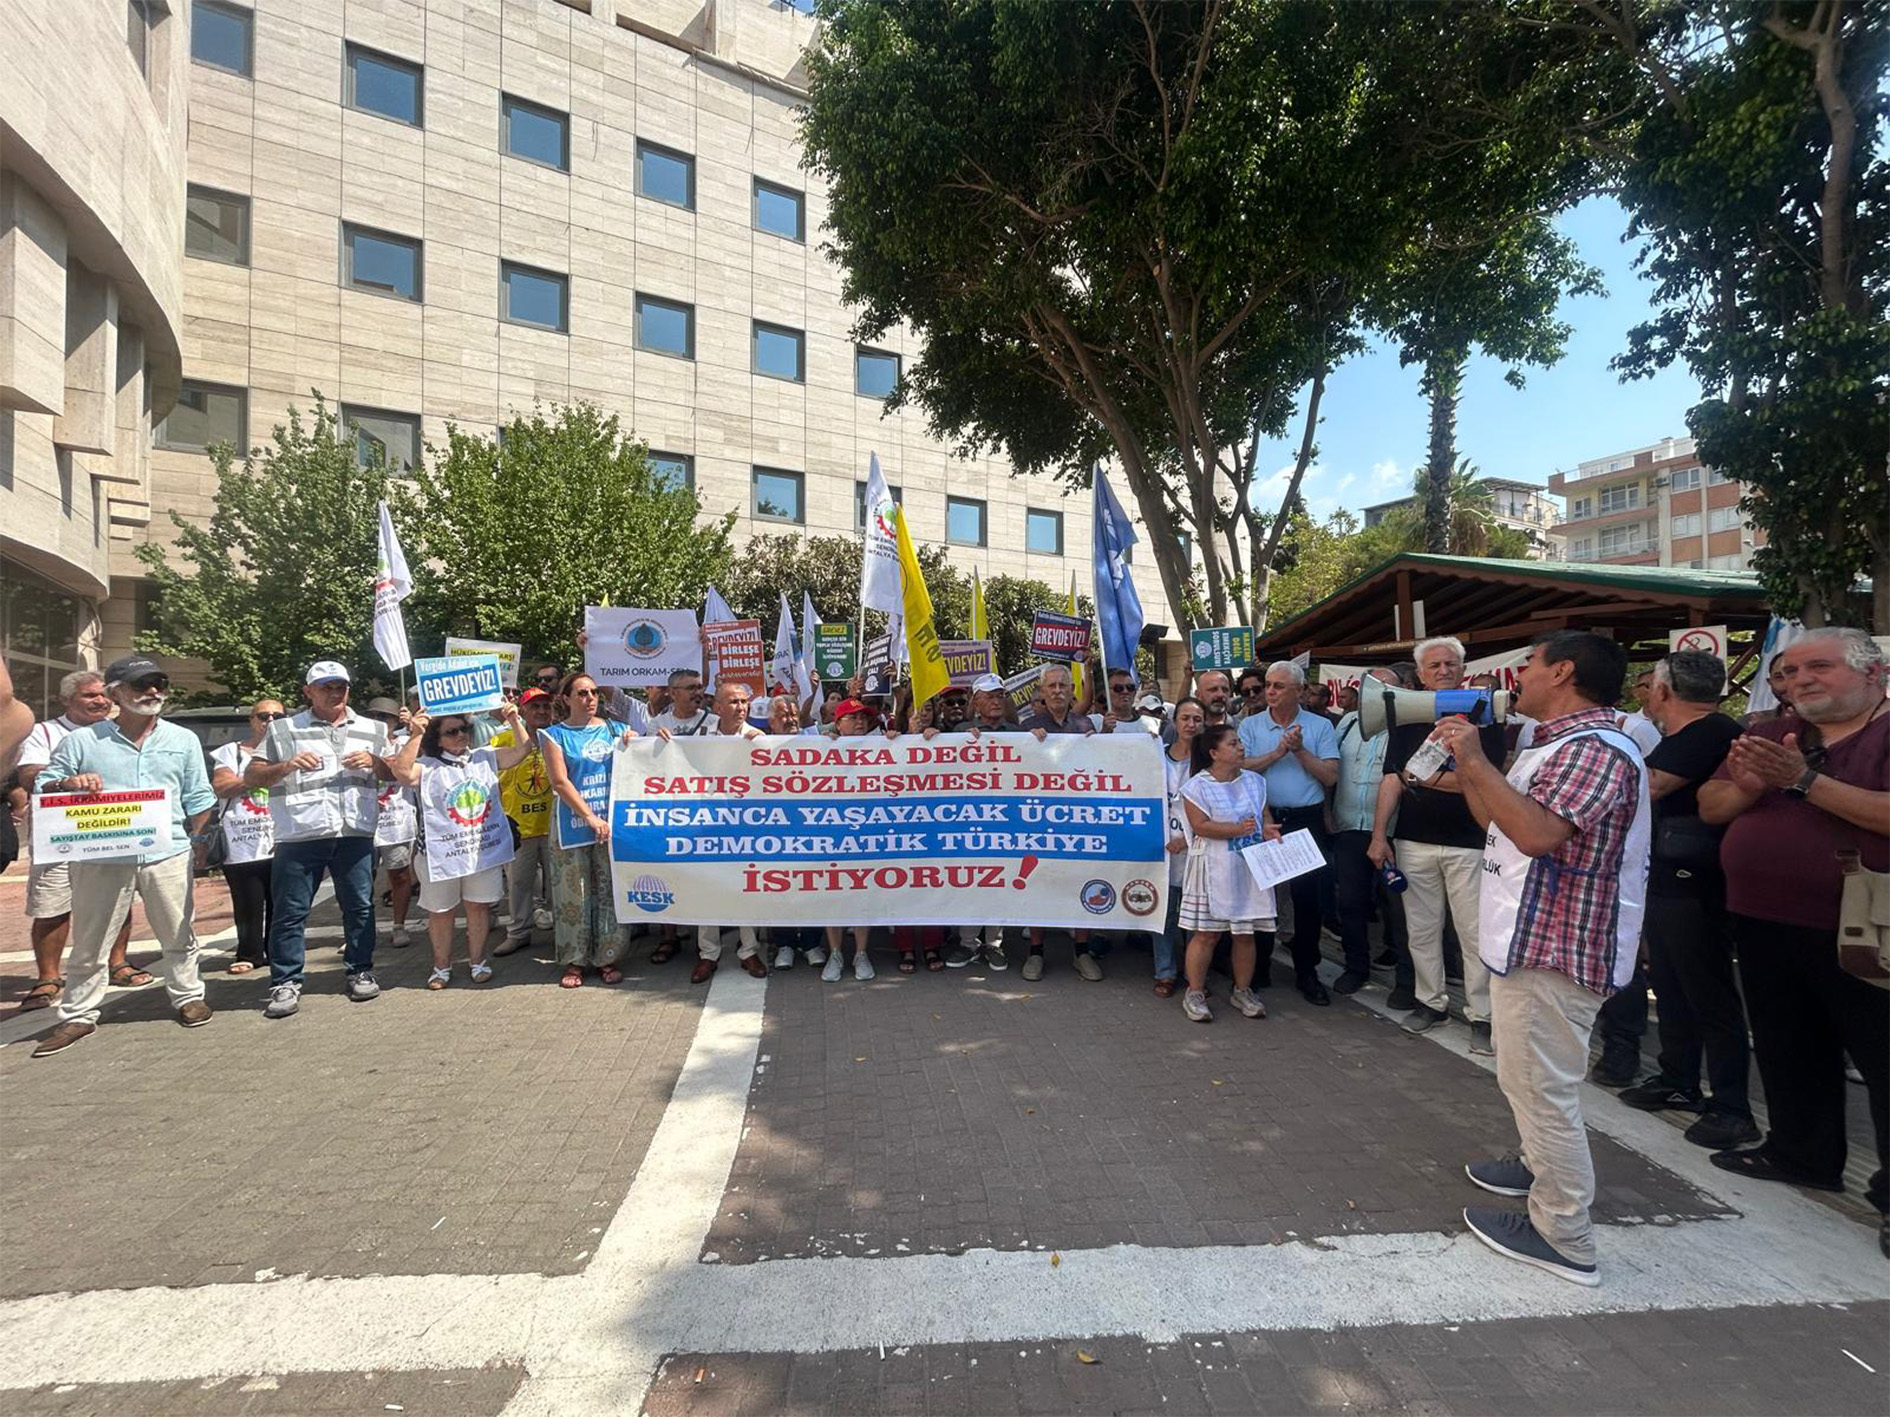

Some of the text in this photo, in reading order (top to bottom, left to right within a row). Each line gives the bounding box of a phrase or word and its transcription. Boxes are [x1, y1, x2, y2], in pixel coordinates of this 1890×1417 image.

[721, 643, 760, 656] BİRLEŞE
[722, 656, 760, 669] BİRLEŞE
[600, 668, 690, 676] TARIM ORKAM-S
[751, 740, 1022, 766] SADAKA DEĞİL
[644, 768, 1132, 798] SATIŞ SÖZLEŞMESİ DEĞİL
[65, 805, 142, 818] KAMU ZARARI
[521, 802, 547, 813] BES
[624, 803, 790, 826] İNSANCA
[798, 803, 1010, 830] YAŞAYACAK
[1018, 799, 1150, 825] ÜCRET
[77, 817, 131, 829] DEĞİLDİR!
[135, 827, 157, 836] SON!
[666, 826, 1108, 856] DEMOKRATİK TÜRKİYE
[1486, 834, 1497, 848] EK
[742, 855, 1040, 893] İSTİYORUZ!
[627, 890, 675, 905] KESK
